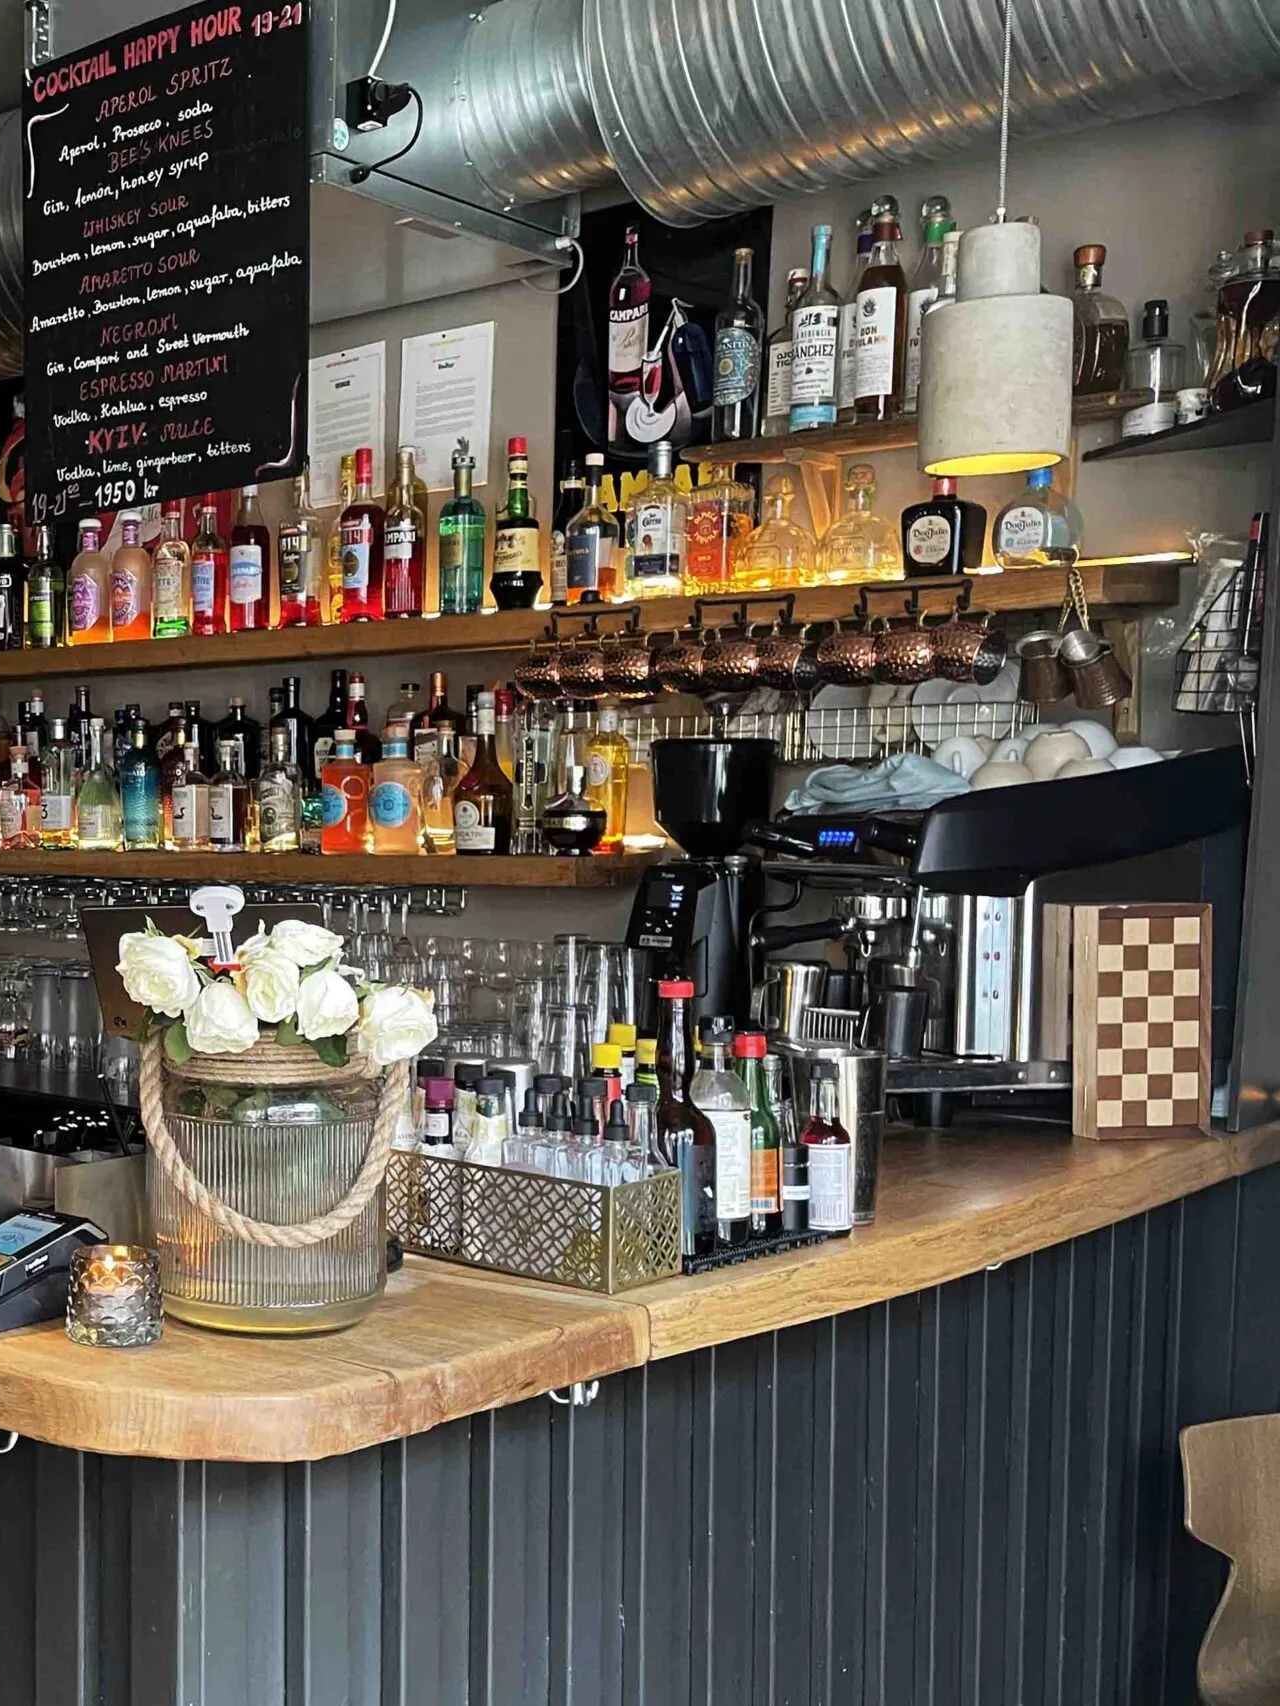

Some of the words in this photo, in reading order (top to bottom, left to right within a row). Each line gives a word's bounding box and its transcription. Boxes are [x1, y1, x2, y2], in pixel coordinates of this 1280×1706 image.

[33, 51, 117, 103] COCKTAIL
[123, 24, 182, 71] HAPPY
[190, 6, 242, 48] HOUR
[95, 84, 157, 123] APEROL
[165, 57, 233, 96] SPRITZ
[177, 100, 213, 122] soda
[107, 139, 152, 174] BEE'S
[158, 120, 214, 153] KNEES
[120, 166, 164, 193] honey
[168, 151, 209, 179] syrup
[83, 207, 142, 239] WHISKEY
[148, 194, 189, 219] SOUR
[247, 194, 291, 216] bitters
[78, 261, 153, 296] AMARETTO
[157, 248, 201, 274] SOUR
[235, 255, 302, 284] aquafaba
[610, 303, 648, 322] CAMPARI
[100, 313, 179, 347] NEGRONI
[73, 352, 120, 375] Campari
[126, 345, 148, 360] and
[156, 334, 190, 355] Sweet
[192, 323, 250, 346] Vermouth
[79, 370, 155, 402] ESPRESSO
[160, 353, 229, 384] MARTINI
[158, 390, 208, 412] espresso
[160, 417, 216, 443] MULE
[206, 441, 252, 457] bitters
[95, 480, 135, 510] 1950
[143, 479, 160, 498] kr
